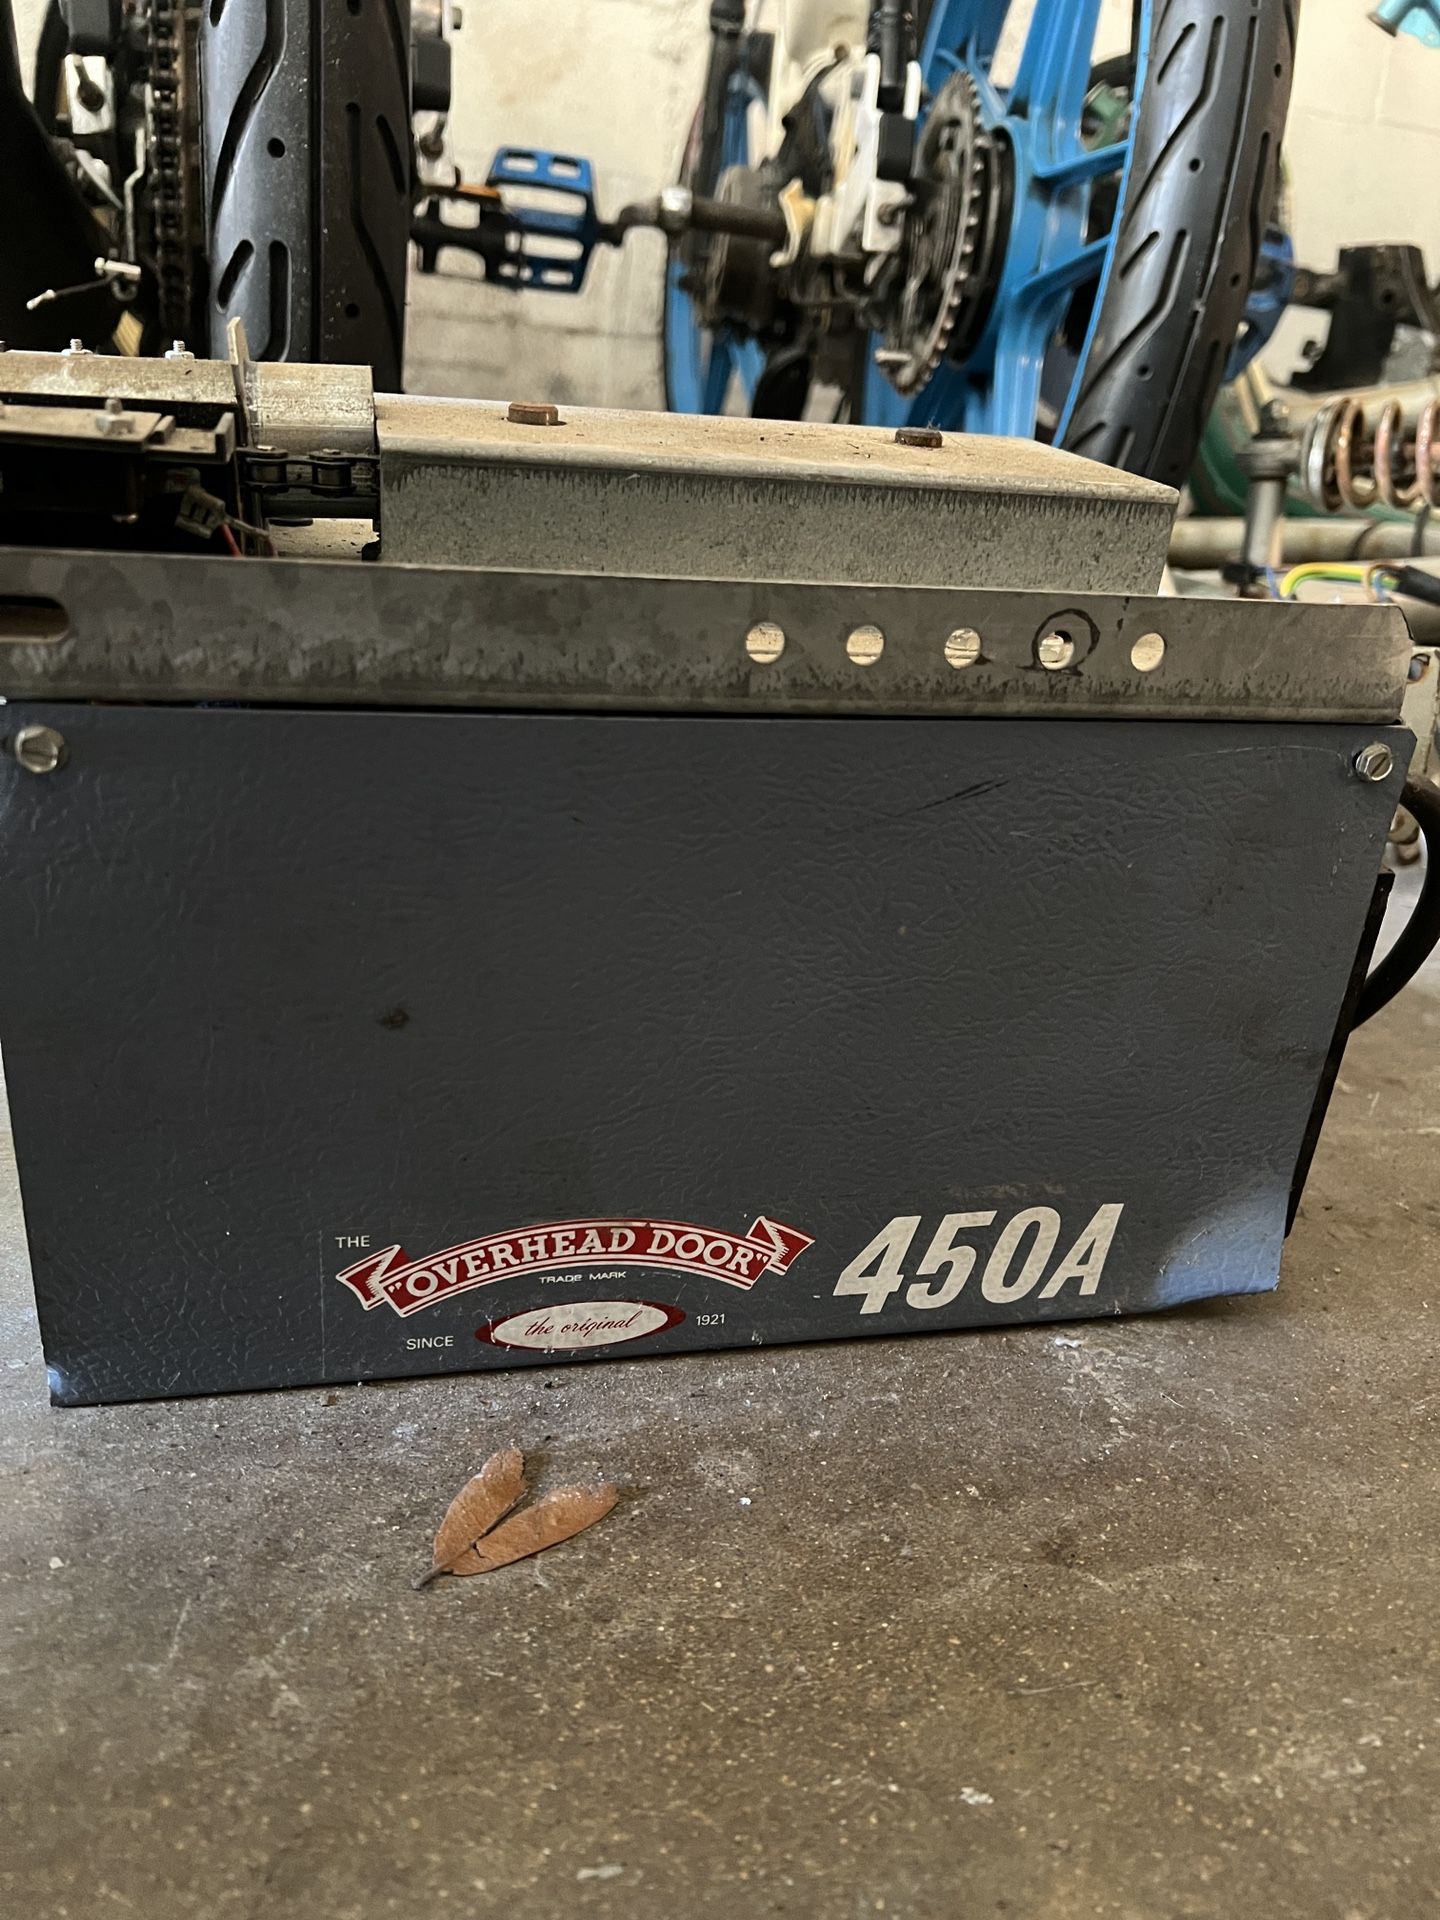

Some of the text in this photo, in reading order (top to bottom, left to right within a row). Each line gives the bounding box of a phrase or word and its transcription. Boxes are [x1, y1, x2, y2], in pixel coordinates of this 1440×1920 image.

[336, 1235, 371, 1249] THE
[832, 1203, 1125, 1315] 450A
[538, 1270, 627, 1285] TRADE MARK
[525, 1310, 644, 1339] the original
[695, 1313, 726, 1327] 1921
[406, 1335, 455, 1351] SINCE
